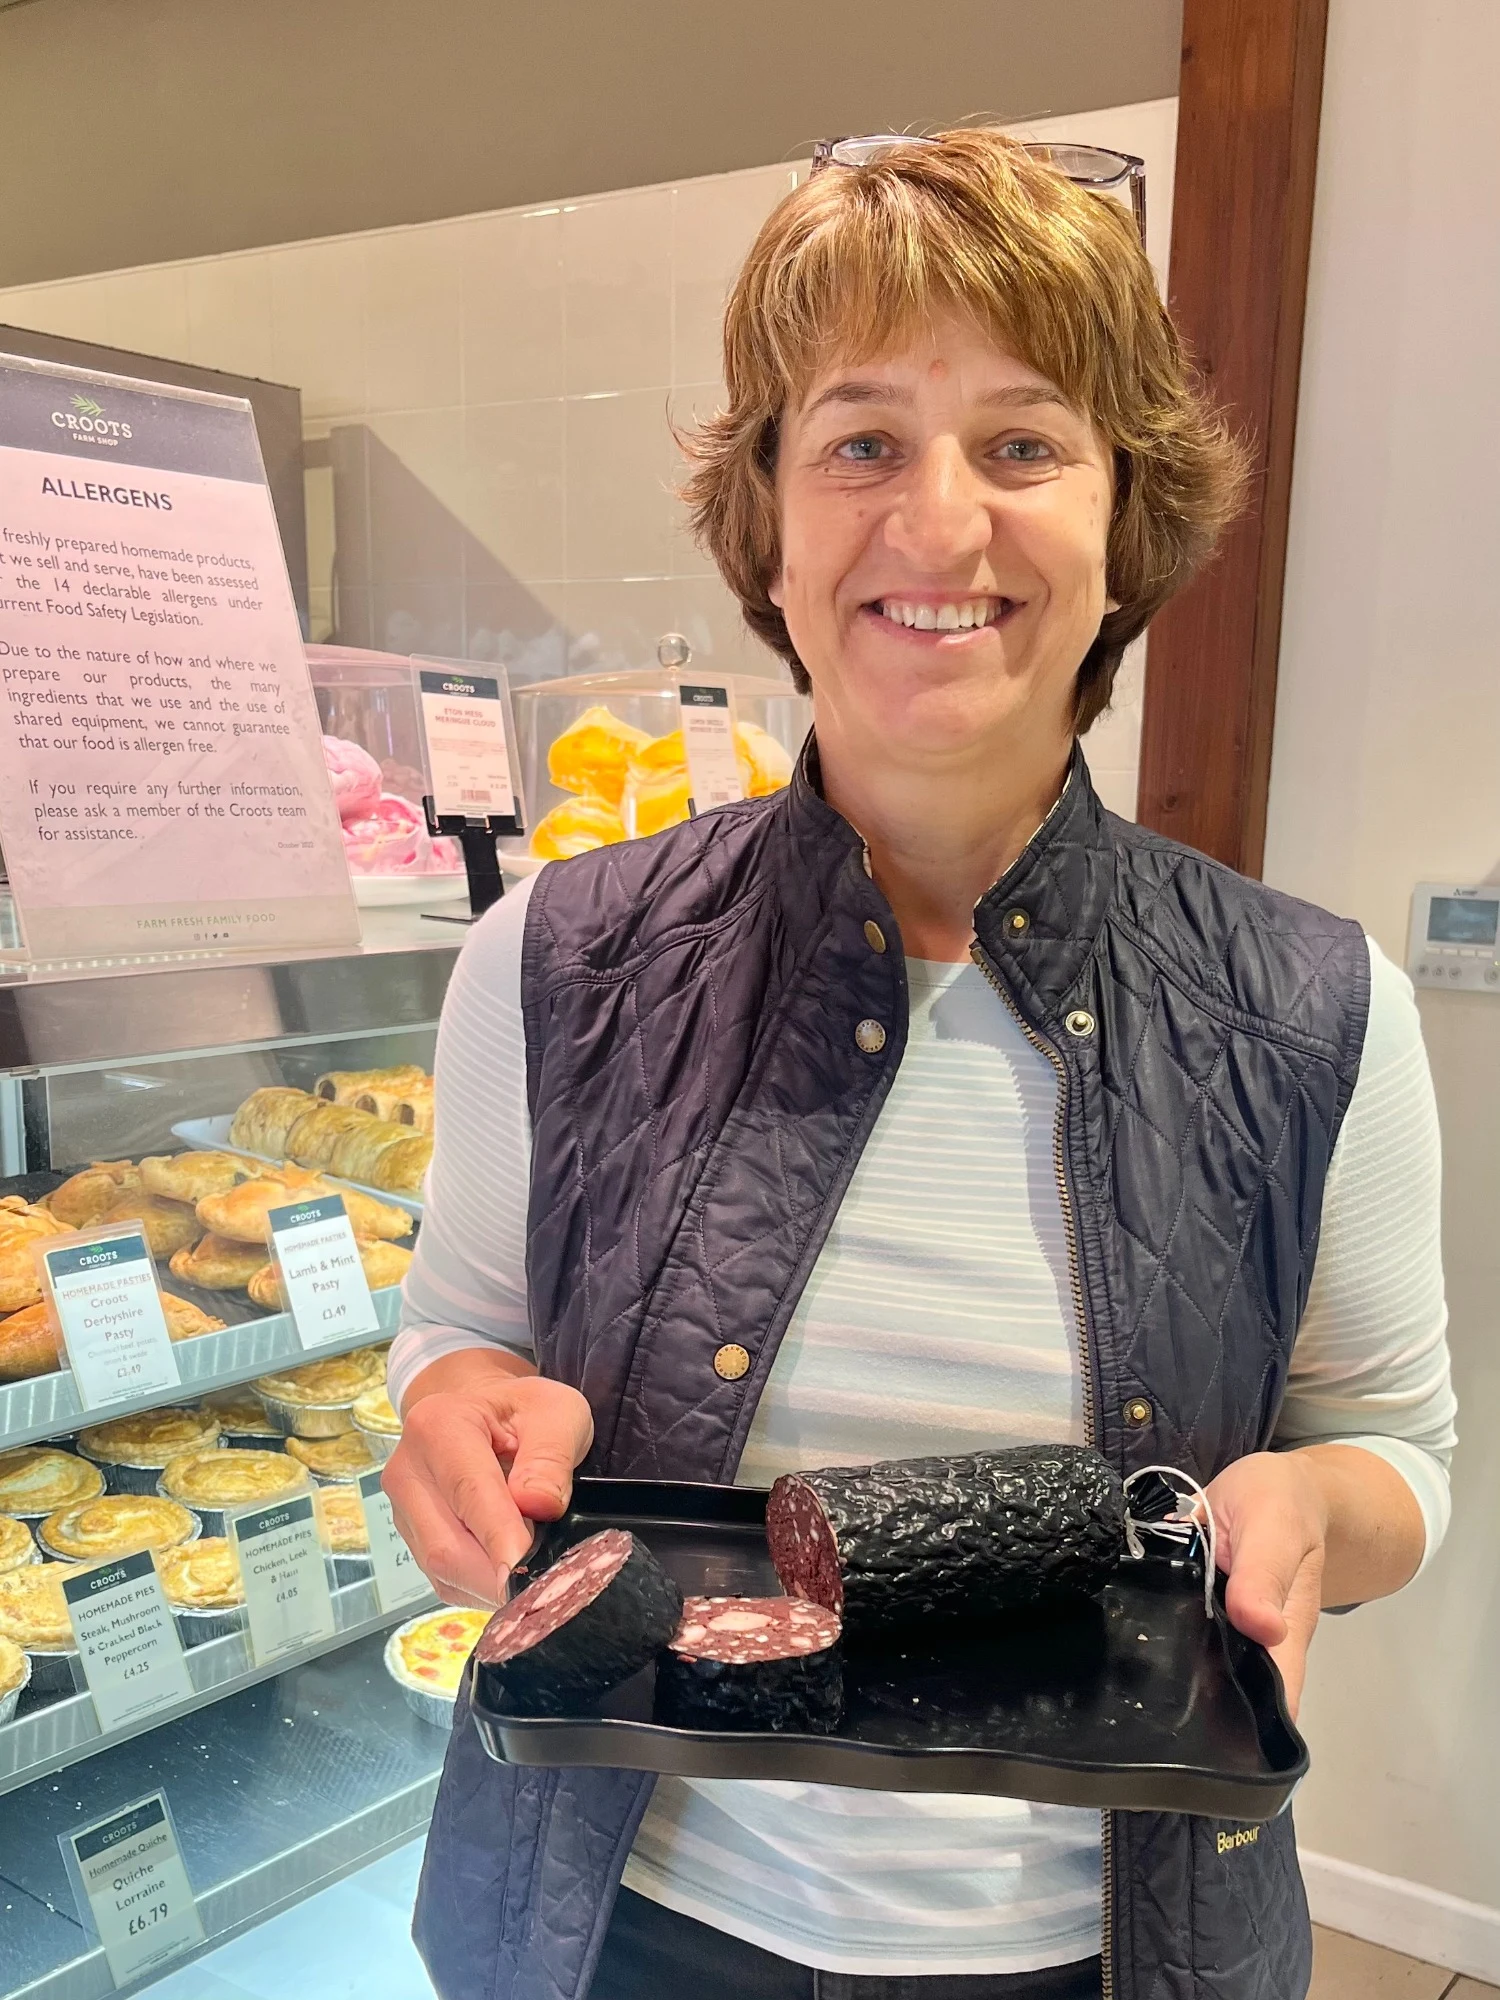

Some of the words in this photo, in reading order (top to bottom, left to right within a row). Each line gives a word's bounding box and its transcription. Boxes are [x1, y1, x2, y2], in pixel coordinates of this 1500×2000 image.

[51, 411, 133, 439] CROOTS
[73, 433, 96, 444] FARM
[97, 437, 118, 447] SHOP
[41, 477, 173, 511] ALLERGENS
[3, 528, 51, 551] freshly
[55, 538, 118, 555] prepared
[121, 541, 194, 563] homemade
[196, 553, 255, 571] products,
[9, 555, 32, 567] we
[37, 555, 60, 570] sell
[64, 559, 90, 573] and
[94, 563, 135, 579] serve,
[137, 564, 169, 581] have
[171, 568, 203, 585] been
[207, 576, 259, 590] assessed
[16, 574, 41, 590] the
[54, 577, 70, 593] 14
[83, 580, 151, 600] declarable
[162, 589, 218, 609] allergens
[228, 596, 263, 611] under
[46, 599, 83, 616] Food
[86, 602, 127, 624] Safety
[131, 606, 204, 626] Legislation.
[0, 641, 29, 657] Due
[35, 647, 51, 658] to
[57, 645, 81, 660] the
[86, 650, 131, 663] nature
[137, 651, 150, 665] of
[154, 651, 182, 666] how
[188, 655, 212, 669] and
[216, 656, 255, 672] where
[259, 662, 277, 673] we
[3, 668, 61, 684] prepare
[83, 672, 107, 684] our
[130, 673, 192, 690] products,
[211, 676, 232, 690] the
[250, 681, 280, 697] many
[442, 682, 475, 693] CROOTS
[7, 688, 88, 707] ingredients
[96, 692, 124, 707] that
[131, 697, 152, 708] we
[160, 698, 182, 709] use
[189, 697, 212, 711] and
[219, 698, 240, 712] the
[247, 702, 267, 713] use
[274, 701, 285, 714] of
[13, 710, 63, 726] shared
[71, 714, 148, 732] equipment,
[155, 719, 175, 731] we
[183, 721, 226, 733] cannot
[232, 722, 290, 736] guarantee
[19, 733, 49, 749] that
[53, 738, 78, 749] our
[82, 735, 115, 750] food
[119, 737, 130, 751] is
[134, 737, 184, 755] allergen
[188, 739, 217, 753] free.
[29, 779, 38, 794] If
[49, 783, 75, 799] you
[87, 782, 137, 799] require
[147, 783, 168, 799] any
[178, 781, 221, 796] further
[230, 782, 303, 797] information,
[34, 803, 78, 821] please
[85, 803, 108, 818] ask
[113, 807, 121, 818] a
[127, 803, 180, 817] member
[187, 803, 199, 817] of
[204, 803, 225, 817] the
[229, 803, 273, 817] Croots
[278, 806, 306, 817] team
[38, 826, 59, 841] for
[65, 827, 138, 840] assistance.
[137, 919, 167, 929] FARM
[171, 916, 203, 927] FRESH
[207, 915, 241, 925] FAMILY
[246, 913, 276, 923] FOOD
[290, 1209, 322, 1223] CROOTS
[80, 1251, 118, 1266] CROOTS
[289, 1263, 318, 1280] Lamb
[320, 1260, 328, 1271] &
[330, 1255, 356, 1268] Mint
[62, 1281, 115, 1300] HOMEMADE
[117, 1272, 152, 1289] PASTIES
[312, 1279, 340, 1293] Pasty
[91, 1293, 129, 1309] Croots
[322, 1304, 347, 1320] £3.49
[84, 1307, 144, 1328] Derbyshire
[104, 1328, 134, 1342] Pasty
[259, 1512, 290, 1530] CROOTS
[245, 1537, 293, 1559] HOMEMADE
[295, 1529, 312, 1542] PIES
[253, 1557, 288, 1575] Chicken,
[289, 1549, 308, 1562] Leek
[396, 1550, 414, 1567] £4.
[90, 1569, 127, 1589] CROOTS
[78, 1594, 134, 1622] HOMEMADE
[135, 1585, 156, 1600] PIES
[81, 1624, 111, 1642] Steak,
[111, 1604, 161, 1630] Mushroom
[88, 1646, 96, 1656] &
[97, 1630, 136, 1652] Cracked
[138, 1619, 163, 1636] Black
[104, 1638, 158, 1666] Peppercorn
[124, 1661, 150, 1680] £4.25
[102, 1821, 138, 1844] CROOTS
[1217, 1825, 1260, 1854] Barbour
[89, 1849, 137, 1879] Homemade
[138, 1833, 168, 1852] Quiche
[113, 1863, 155, 1892] Quiche
[116, 1879, 166, 1911] Lorraine
[128, 1902, 168, 1936] £6.79
